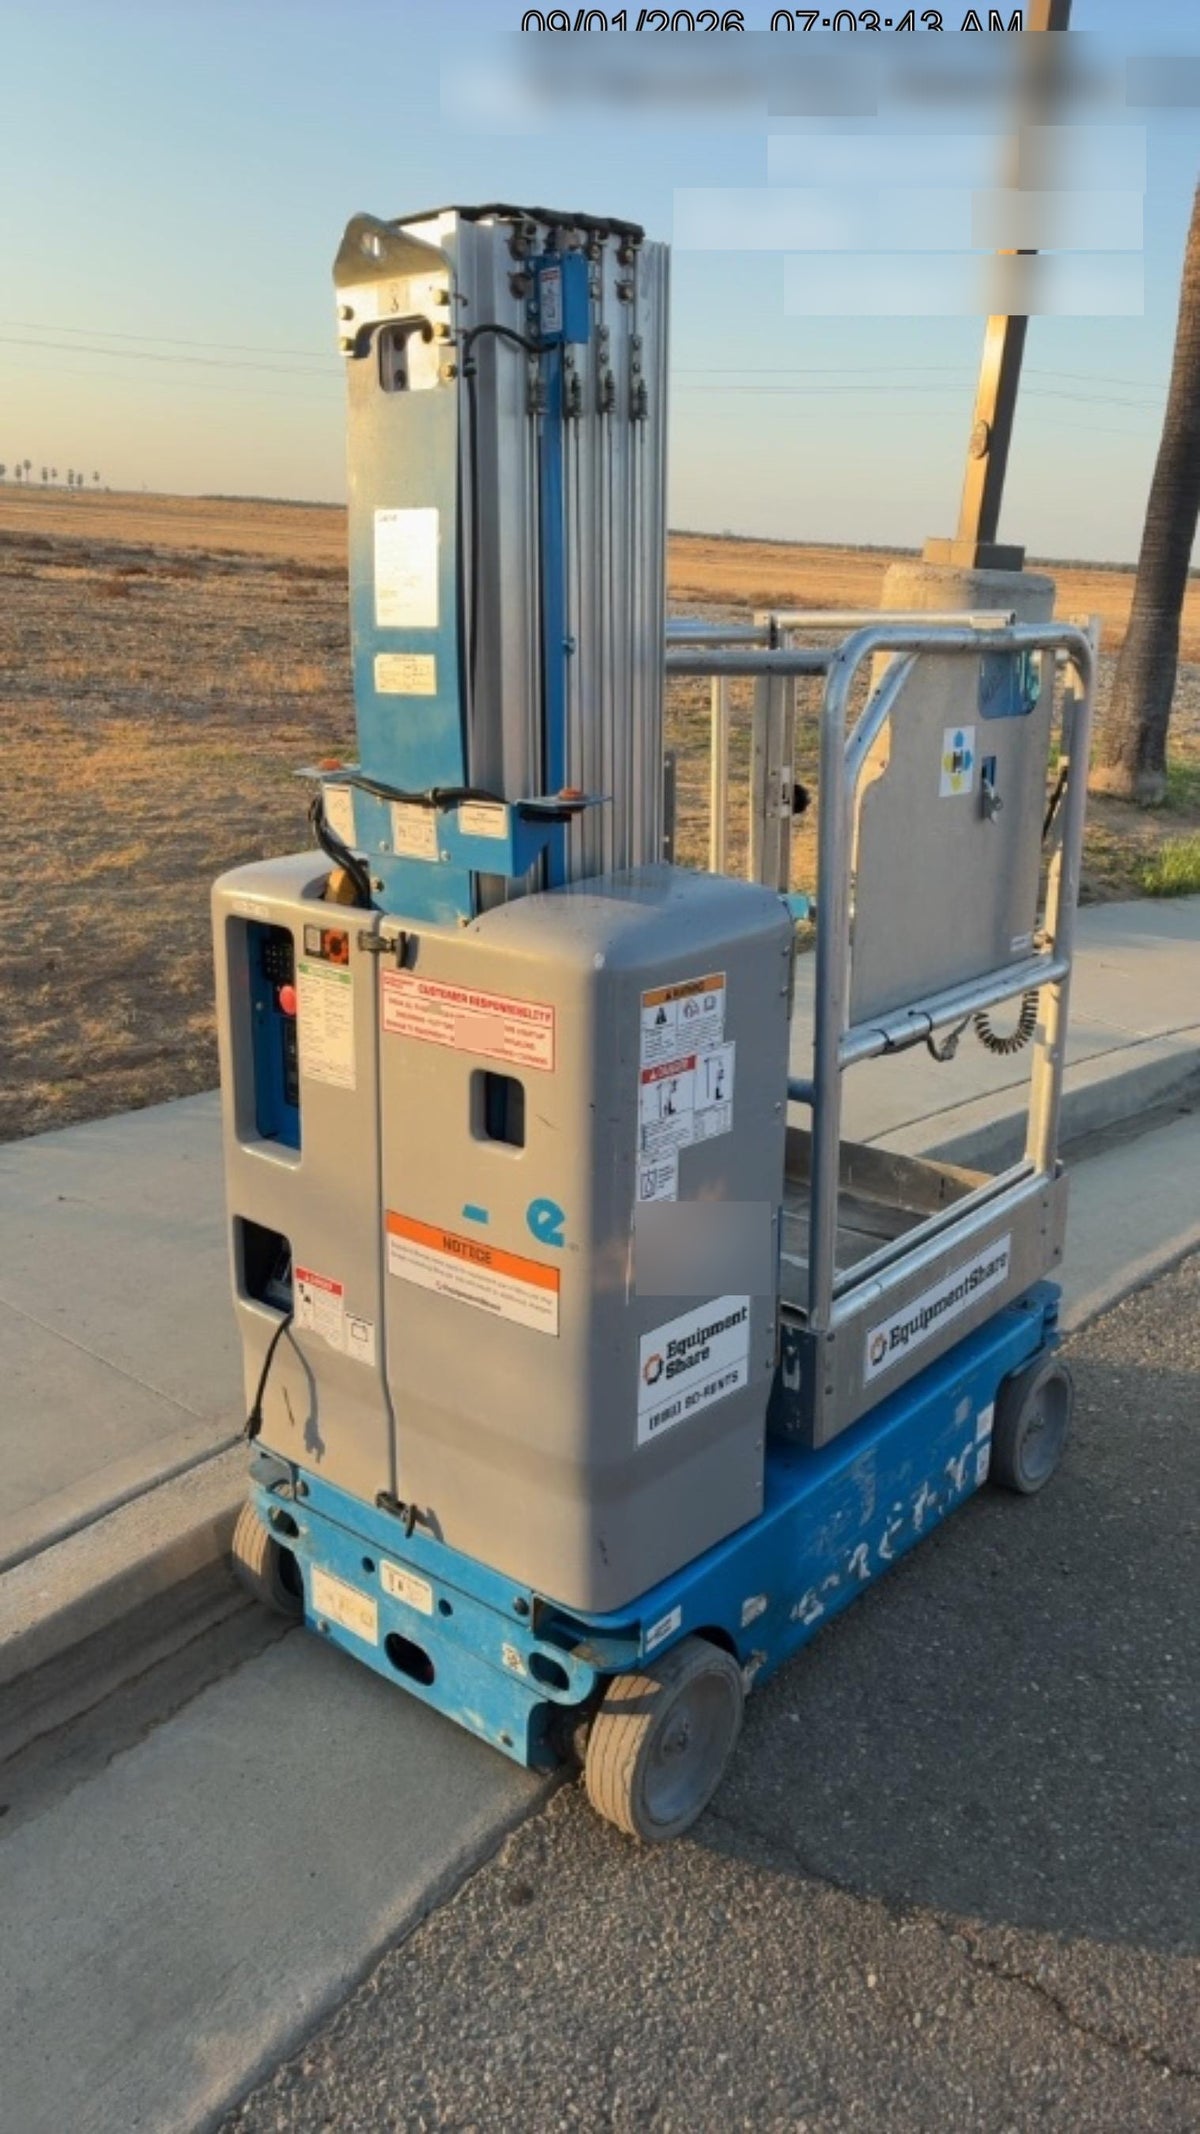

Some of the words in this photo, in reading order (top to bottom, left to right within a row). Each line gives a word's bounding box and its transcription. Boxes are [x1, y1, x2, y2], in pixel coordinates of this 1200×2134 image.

[442, 1235, 492, 1265] NOTICE
[889, 1252, 1008, 1351] EquipmentShare
[666, 1305, 747, 1359] Equipment
[666, 1347, 711, 1380] Share
